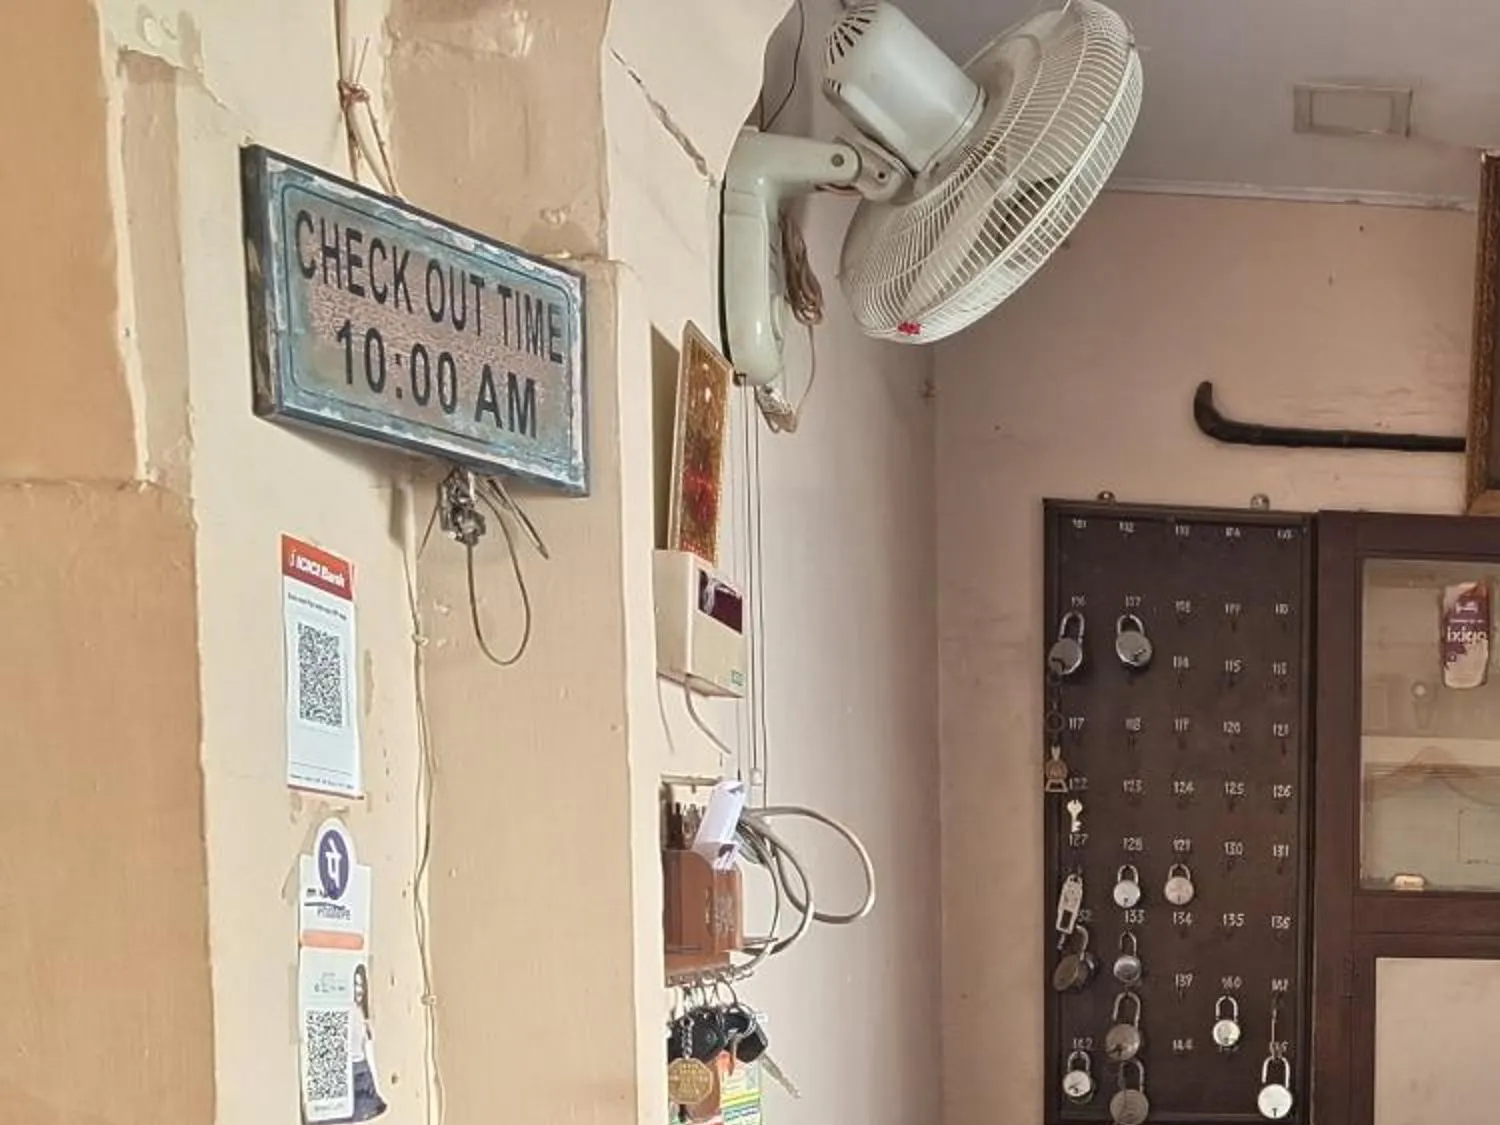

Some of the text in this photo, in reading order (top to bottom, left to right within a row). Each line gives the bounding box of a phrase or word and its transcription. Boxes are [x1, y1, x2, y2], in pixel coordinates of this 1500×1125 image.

[295, 210, 563, 364] CHECK OUT TIME
[336, 319, 538, 438] 10:00 AM
[1225, 660, 1241, 672] 115
[1069, 717, 1085, 730] 117
[1223, 721, 1241, 734] 120
[1273, 724, 1289, 737] 121
[1123, 779, 1143, 793] 123
[1174, 780, 1194, 794] 124
[1225, 782, 1245, 796] 125
[1273, 784, 1292, 798] 126
[1069, 833, 1088, 847] 127
[1225, 842, 1243, 856] 130
[1273, 844, 1290, 857] 131
[1124, 910, 1145, 924] 133
[1173, 911, 1193, 926] 134
[1223, 913, 1245, 927] 135
